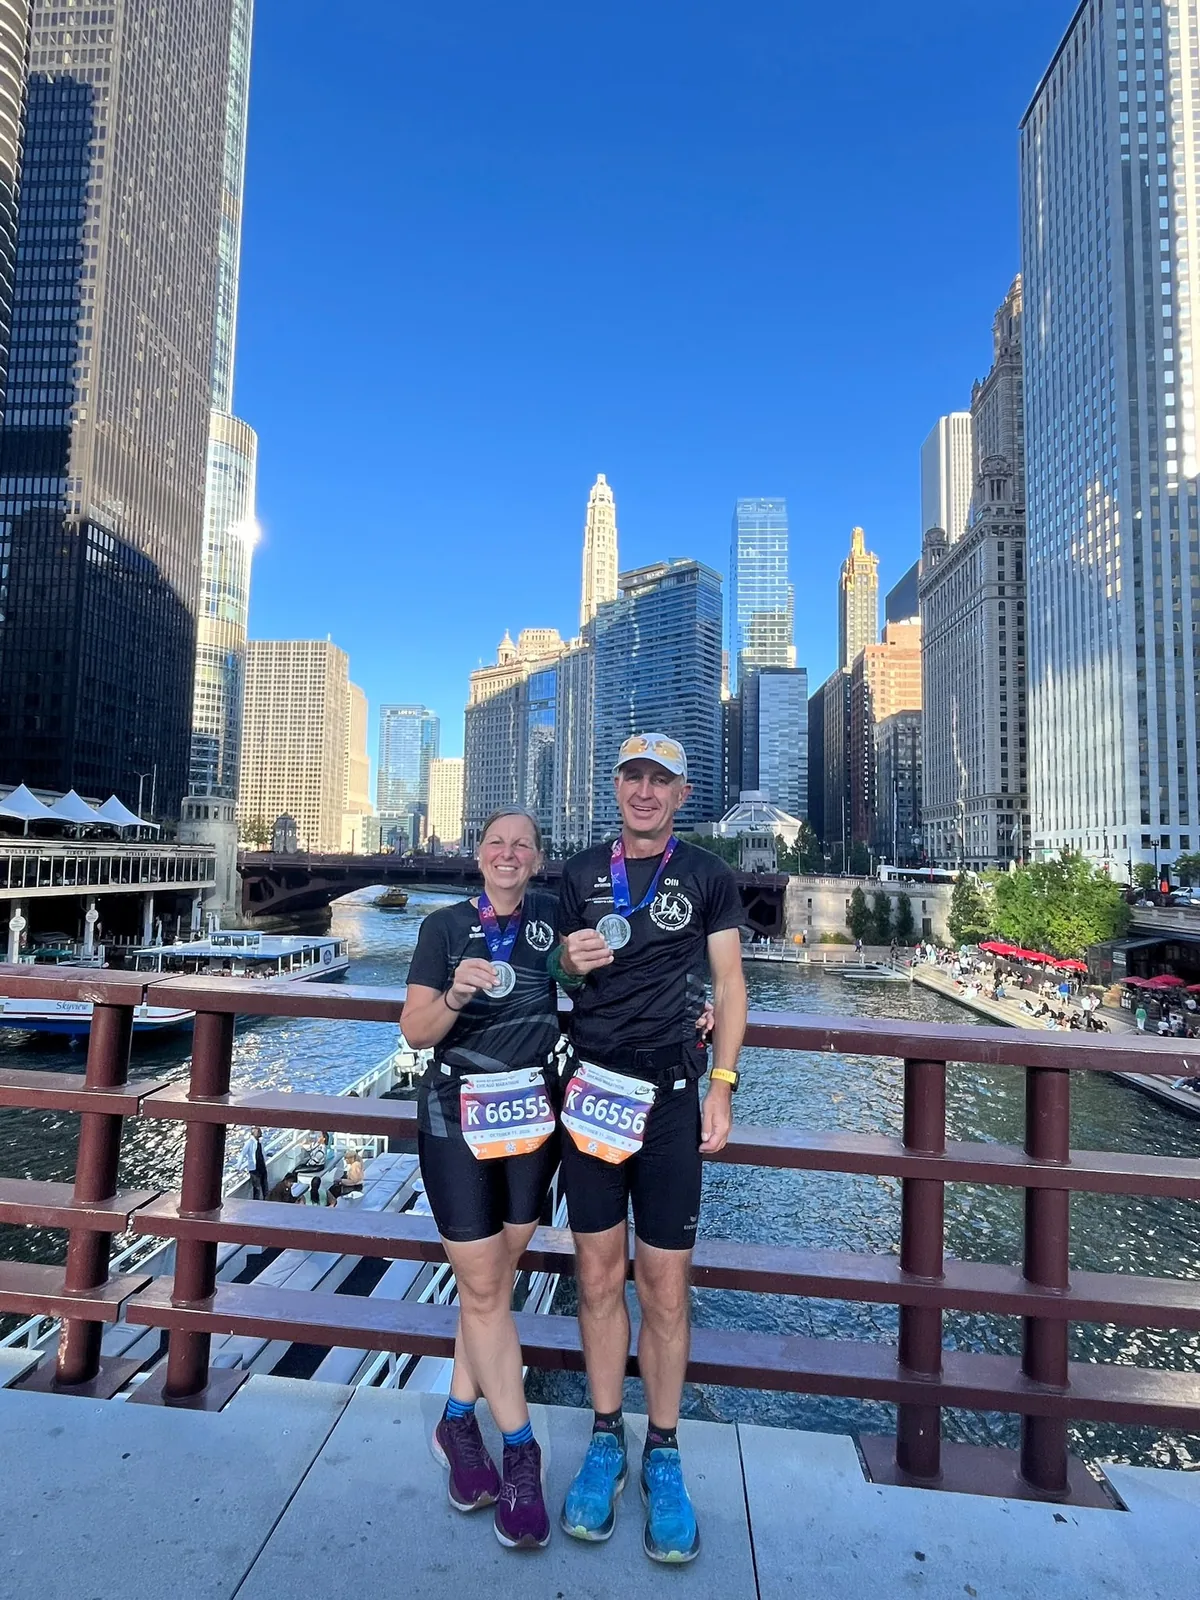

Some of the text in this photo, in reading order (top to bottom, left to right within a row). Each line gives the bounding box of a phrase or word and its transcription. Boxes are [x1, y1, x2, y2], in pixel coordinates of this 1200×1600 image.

[55, 1002, 88, 1011] Skyview
[467, 1095, 551, 1126] K 66555
[566, 1089, 647, 1135] K 66556
